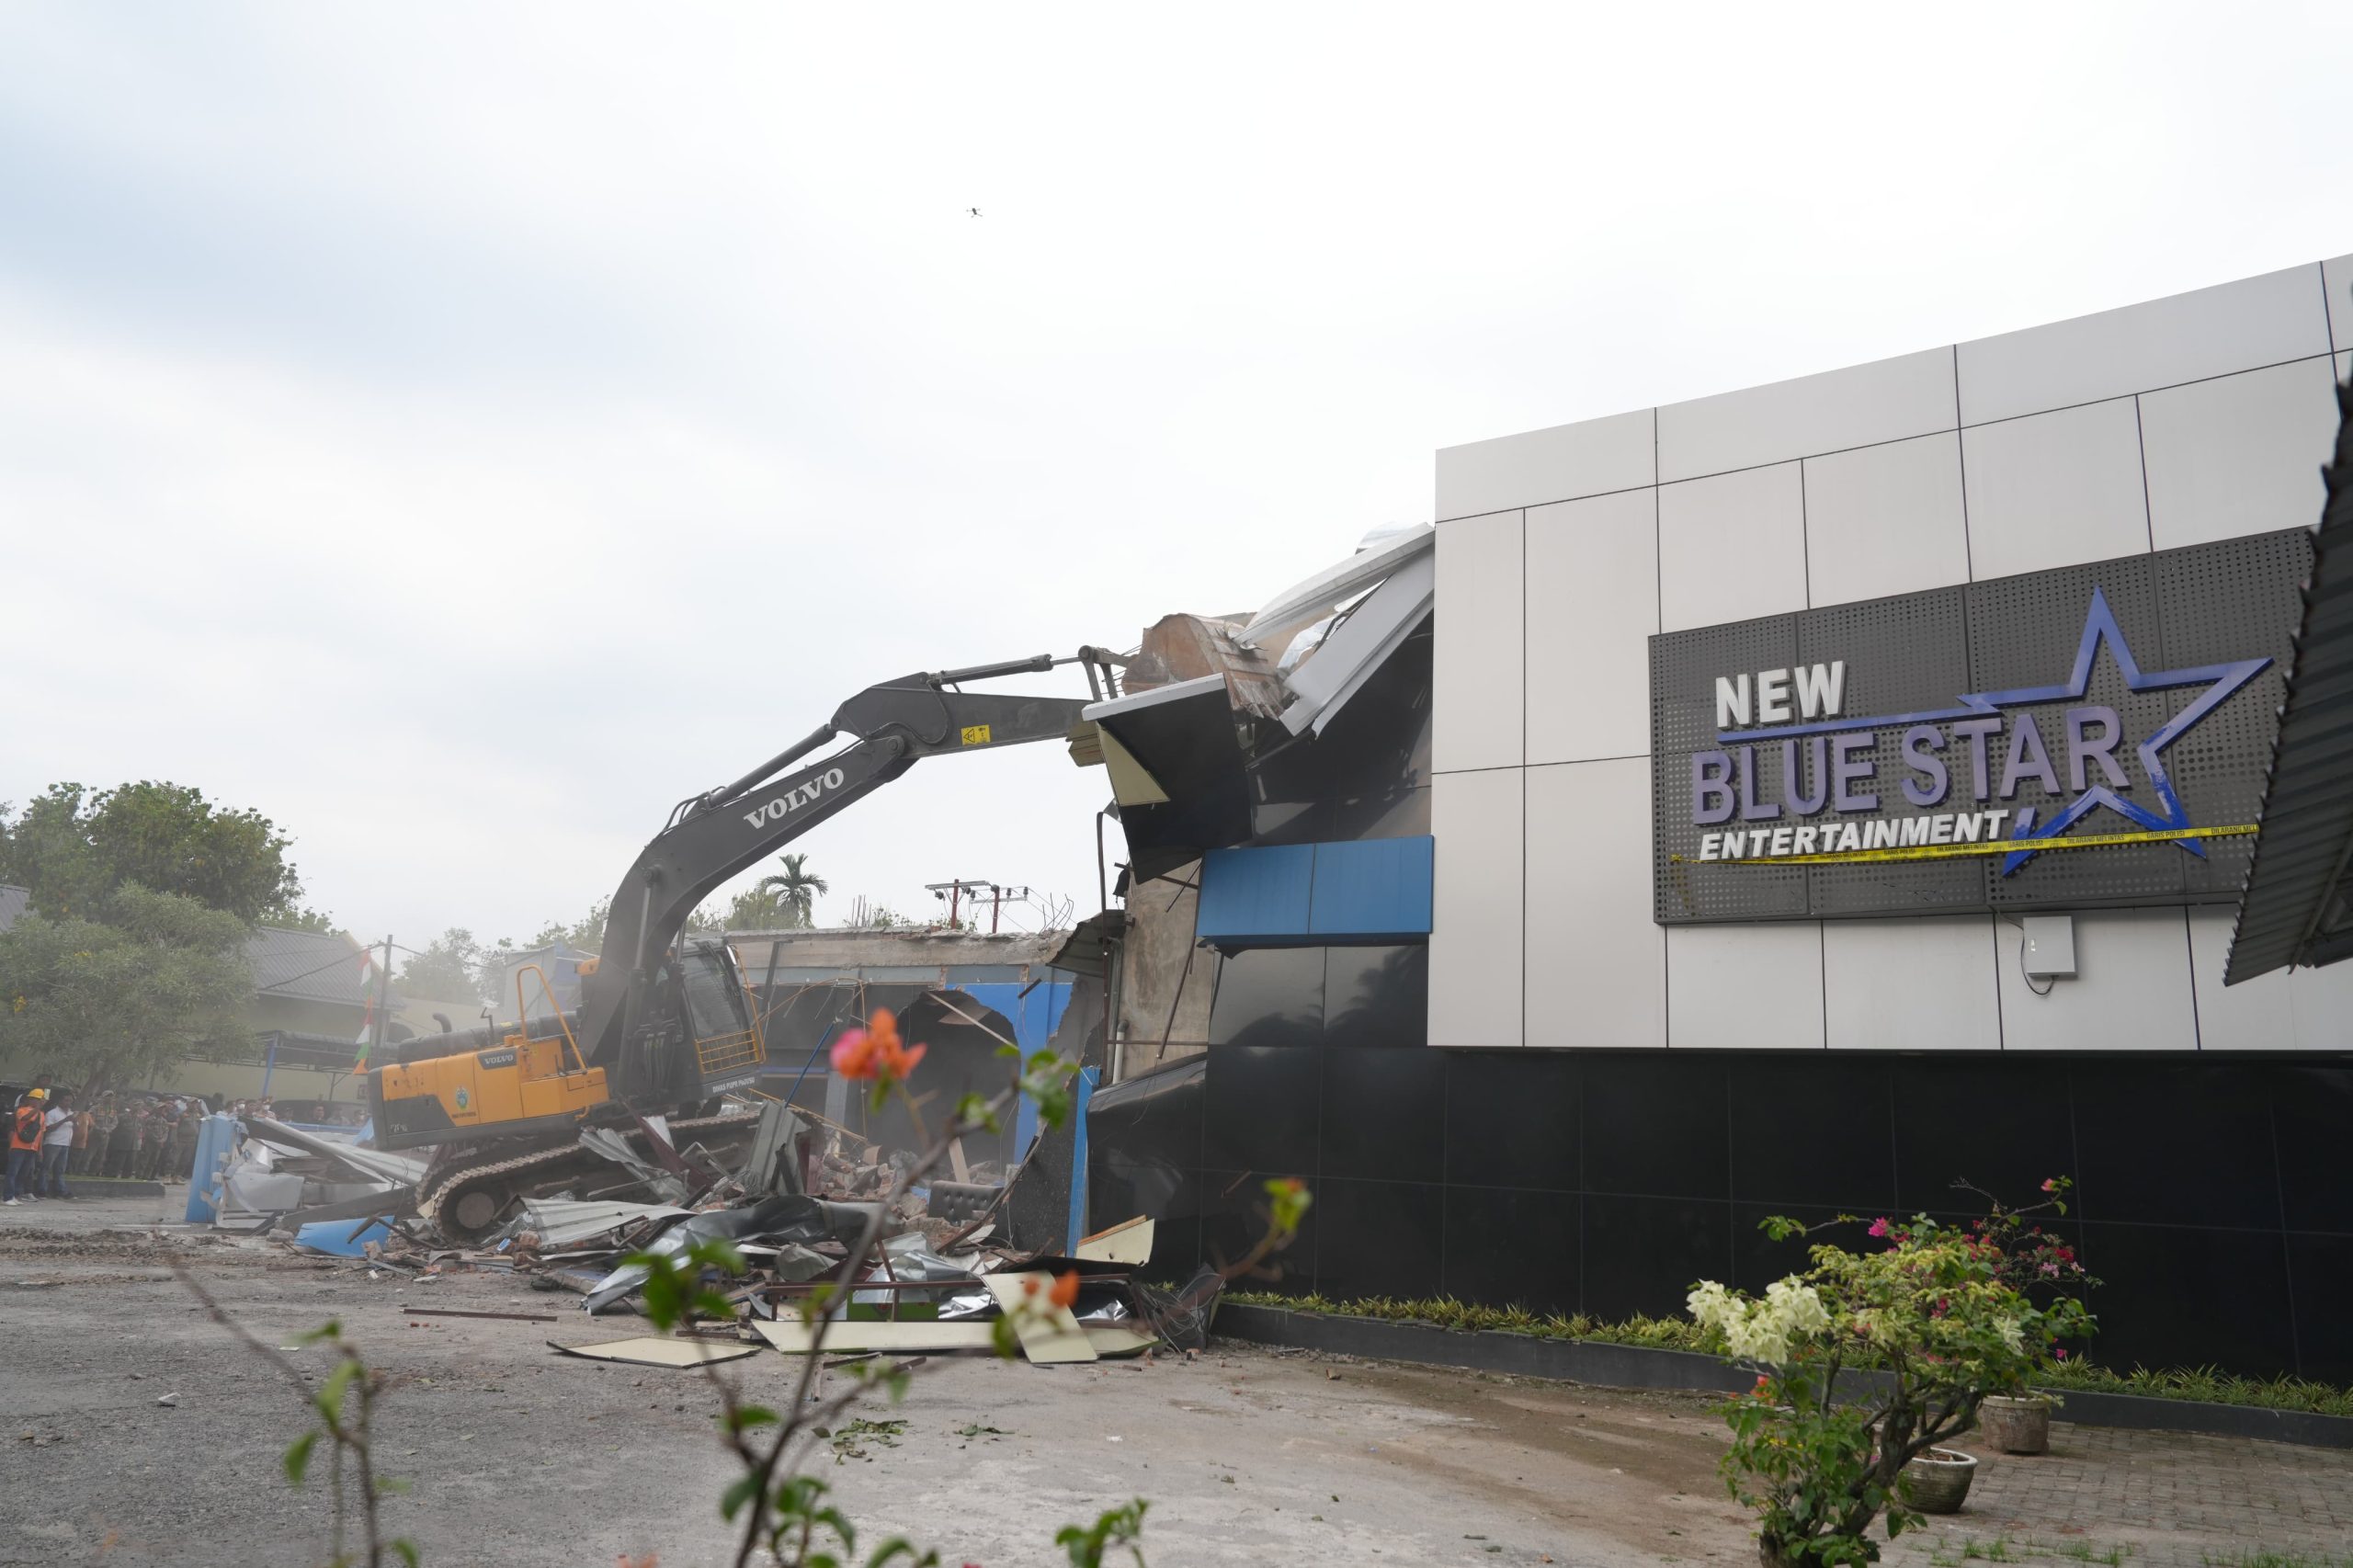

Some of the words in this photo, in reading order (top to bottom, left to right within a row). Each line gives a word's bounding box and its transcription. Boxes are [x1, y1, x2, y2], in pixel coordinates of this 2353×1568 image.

[1716, 661, 1846, 729] NEW
[1692, 733, 1881, 826] BLUE
[1901, 706, 2131, 807] STAR
[743, 767, 845, 829] VOLVO
[1699, 809, 2009, 861] ENTERTAINMENT
[2066, 836, 2095, 845] DILARANG
[2097, 834, 2124, 843] MELINTAS
[2146, 831, 2164, 839] GARIS
[2211, 825, 2241, 835] DILARANG
[484, 1054, 514, 1064] VOLVO
